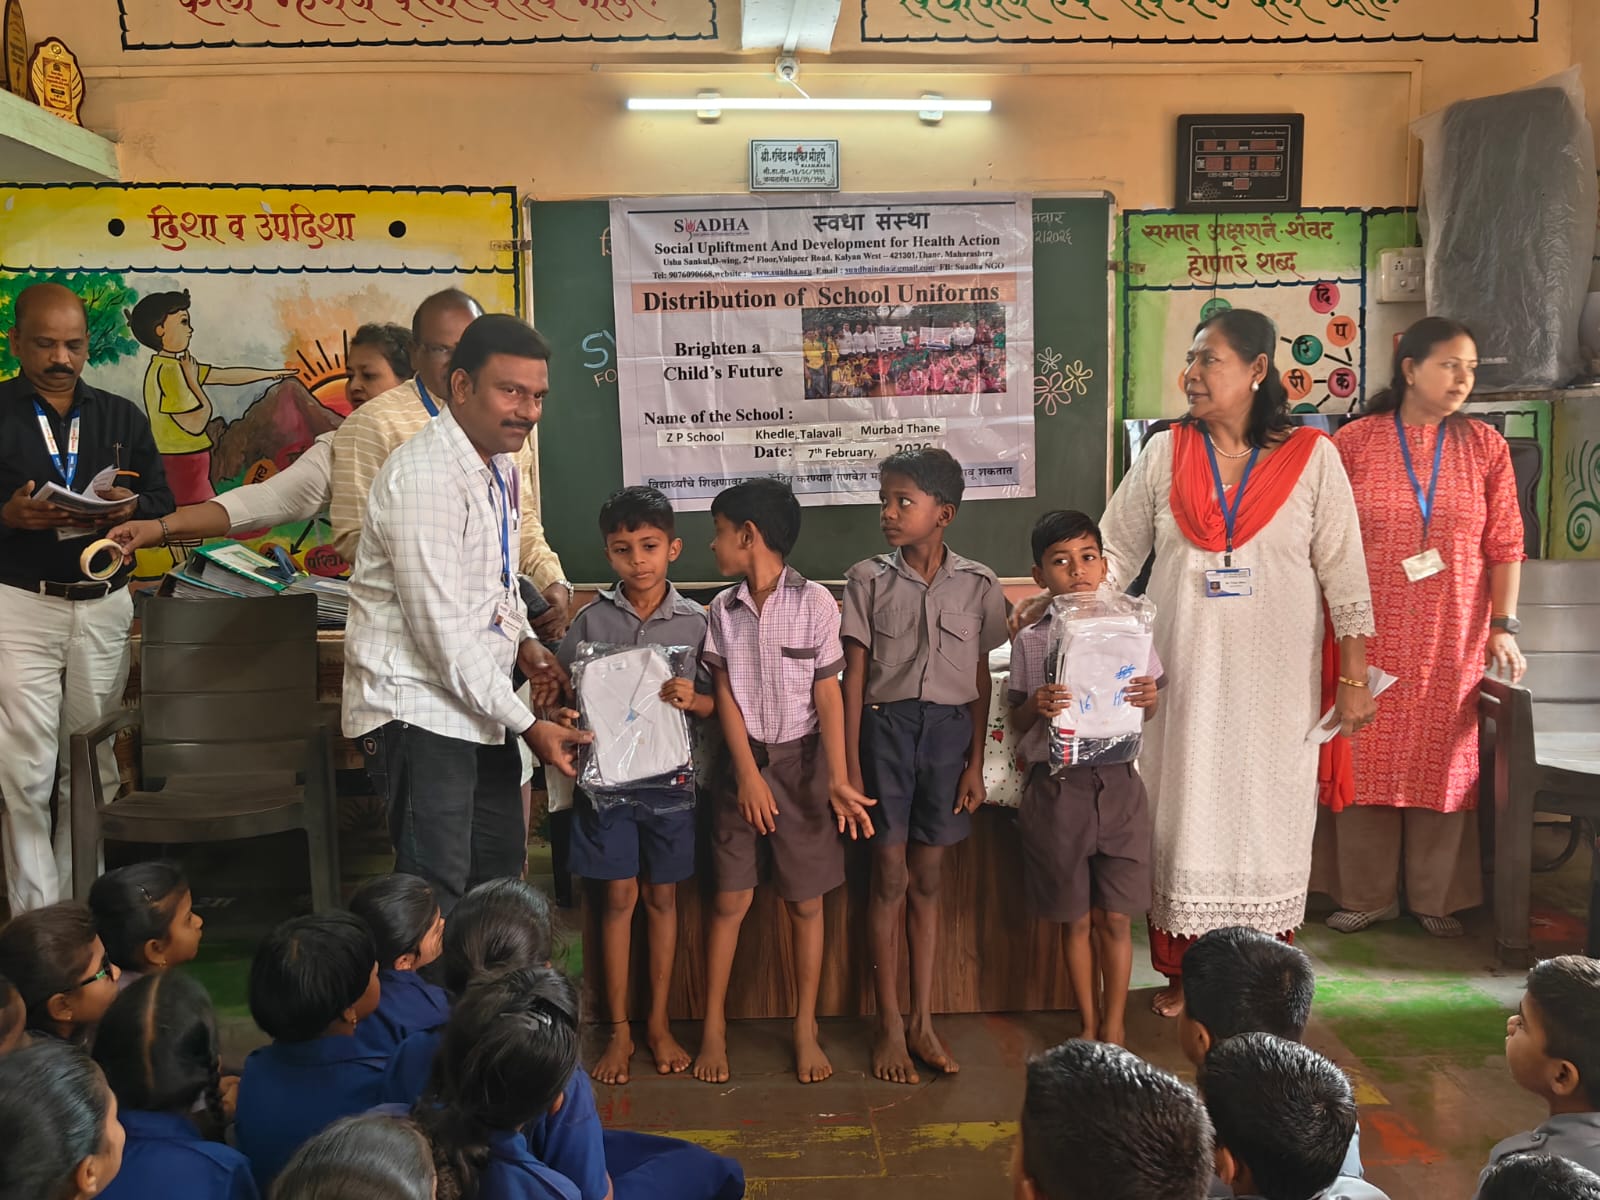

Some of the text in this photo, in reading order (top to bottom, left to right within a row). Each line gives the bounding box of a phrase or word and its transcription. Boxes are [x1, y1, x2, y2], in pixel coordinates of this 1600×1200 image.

[147, 203, 356, 252] दिशा व उपदिशा
[813, 206, 930, 232] स्वधा संस्था
[655, 233, 1000, 256] Social Upliftment And Development for Health Action
[663, 258, 681, 266] Usha
[834, 252, 861, 263] Kalyan
[864, 250, 881, 259] West
[945, 248, 993, 258] Maharashtra
[653, 271, 667, 280] Tel:
[985, 260, 1005, 270] NGO
[643, 282, 1000, 311] Distribution of School Uniforms
[675, 342, 762, 359] Brighten a
[727, 364, 783, 379] Future
[644, 412, 687, 425] Name
[691, 410, 706, 424] of
[710, 409, 732, 422] the
[736, 407, 784, 421] School
[666, 433, 673, 443] Z
[677, 433, 684, 442] P
[687, 430, 725, 443] School
[861, 424, 904, 436] Murbad
[907, 423, 941, 434] Thane
[754, 446, 792, 459] Date:
[808, 447, 823, 459] 7th
[826, 445, 877, 459] February,
[978, 465, 1013, 476] शकतात
